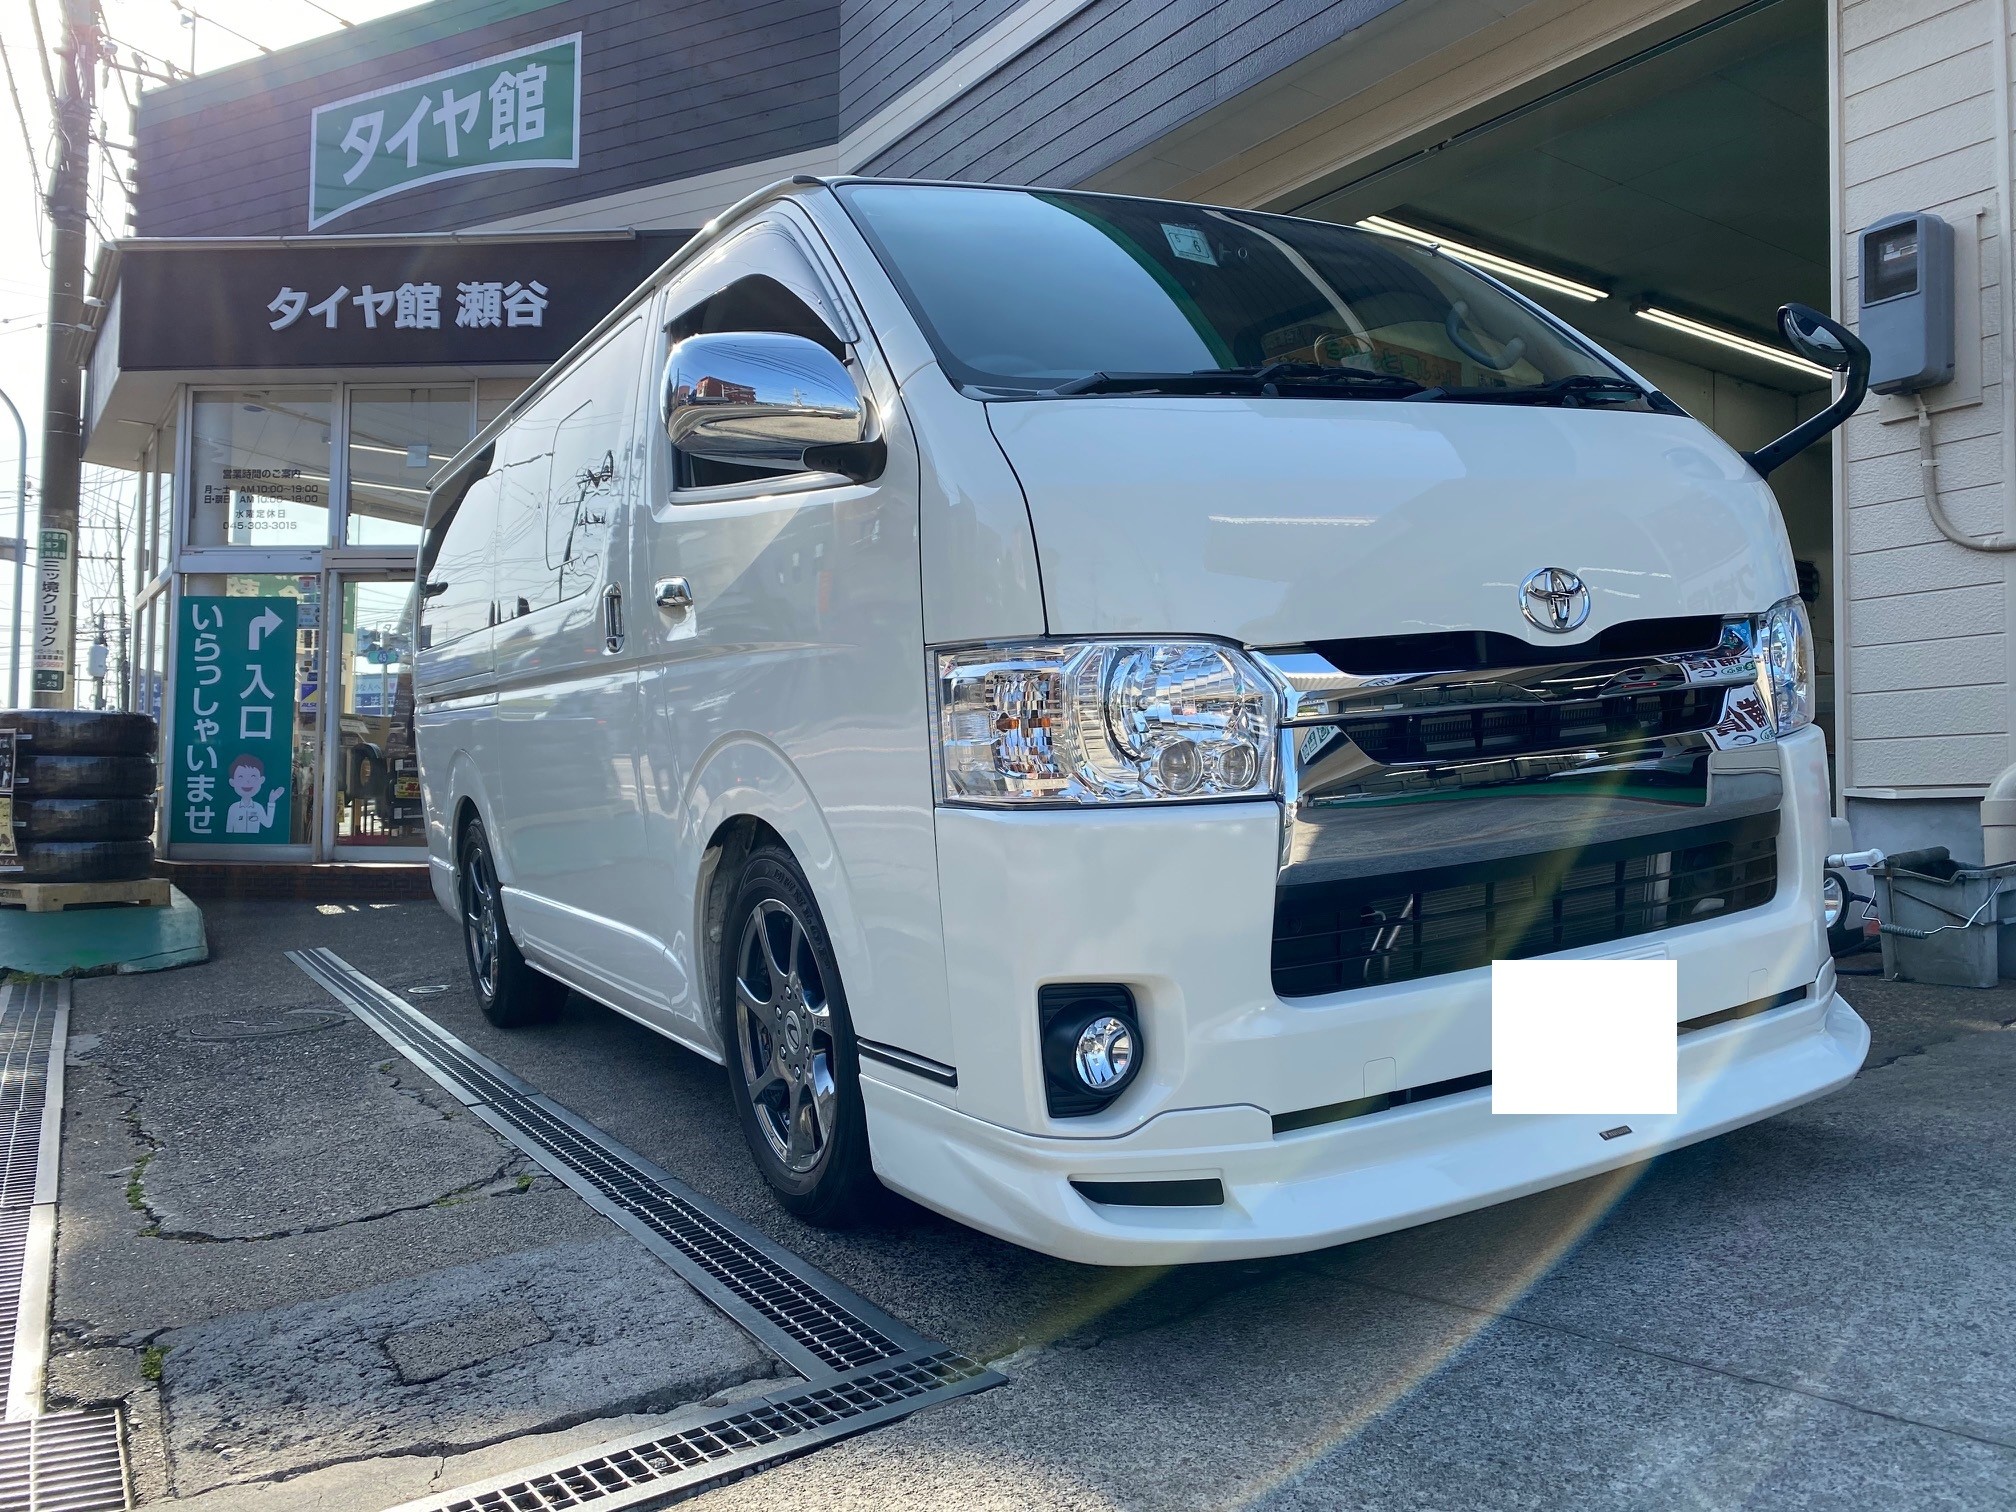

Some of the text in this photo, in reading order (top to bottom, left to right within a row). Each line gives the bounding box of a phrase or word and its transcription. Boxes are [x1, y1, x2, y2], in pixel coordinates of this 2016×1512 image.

[340, 63, 547, 186] タイヤ館
[266, 280, 549, 331] タイヤ館 瀬谷
[222, 469, 301, 480] 営業時間のご案内
[223, 521, 297, 530] 045-303-3015
[235, 509, 286, 519] 水曜定休日
[184, 604, 224, 834] いらっしゃいませ
[239, 663, 275, 740] 入口
